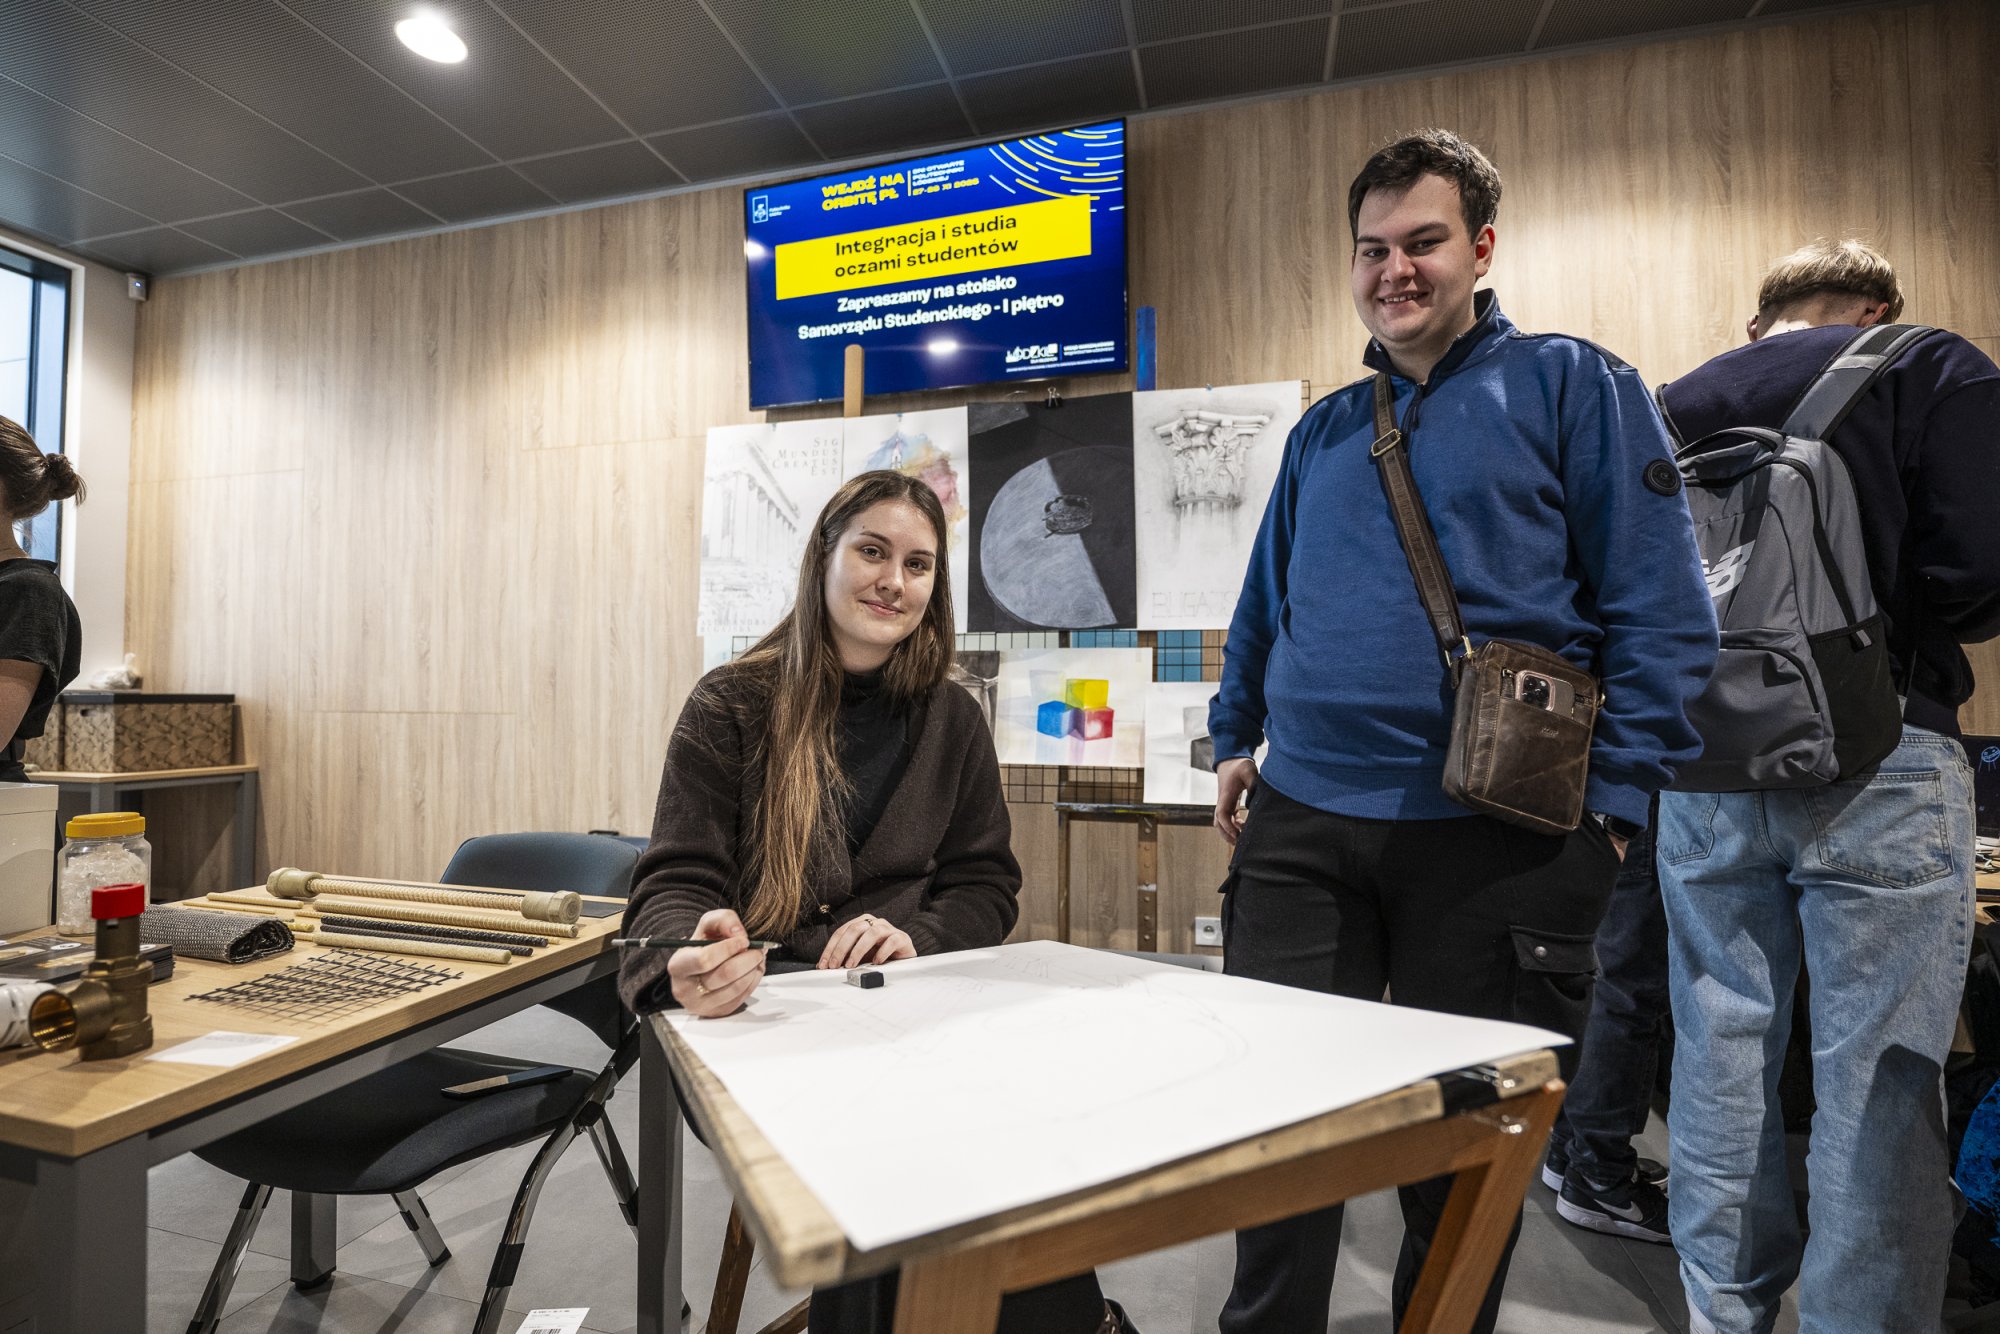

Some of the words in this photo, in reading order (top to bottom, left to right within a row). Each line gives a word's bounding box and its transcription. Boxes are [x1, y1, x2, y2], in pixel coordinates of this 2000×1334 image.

[822, 175, 877, 198] WEJDŹ
[879, 173, 905, 187] NA
[822, 190, 877, 211] ORBITĘ
[879, 188, 900, 202] PŁ
[835, 228, 936, 256] Integracja
[941, 224, 946, 239] i
[951, 215, 1017, 238] studia
[835, 254, 901, 278] oczami
[906, 239, 1019, 267] studentów
[837, 286, 932, 313] Zapraszamy
[933, 283, 955, 299] na
[956, 275, 1018, 296] stoisko
[798, 316, 883, 341] Samorządu
[884, 301, 992, 329] Studenckiego
[1010, 293, 1065, 316] piętro
